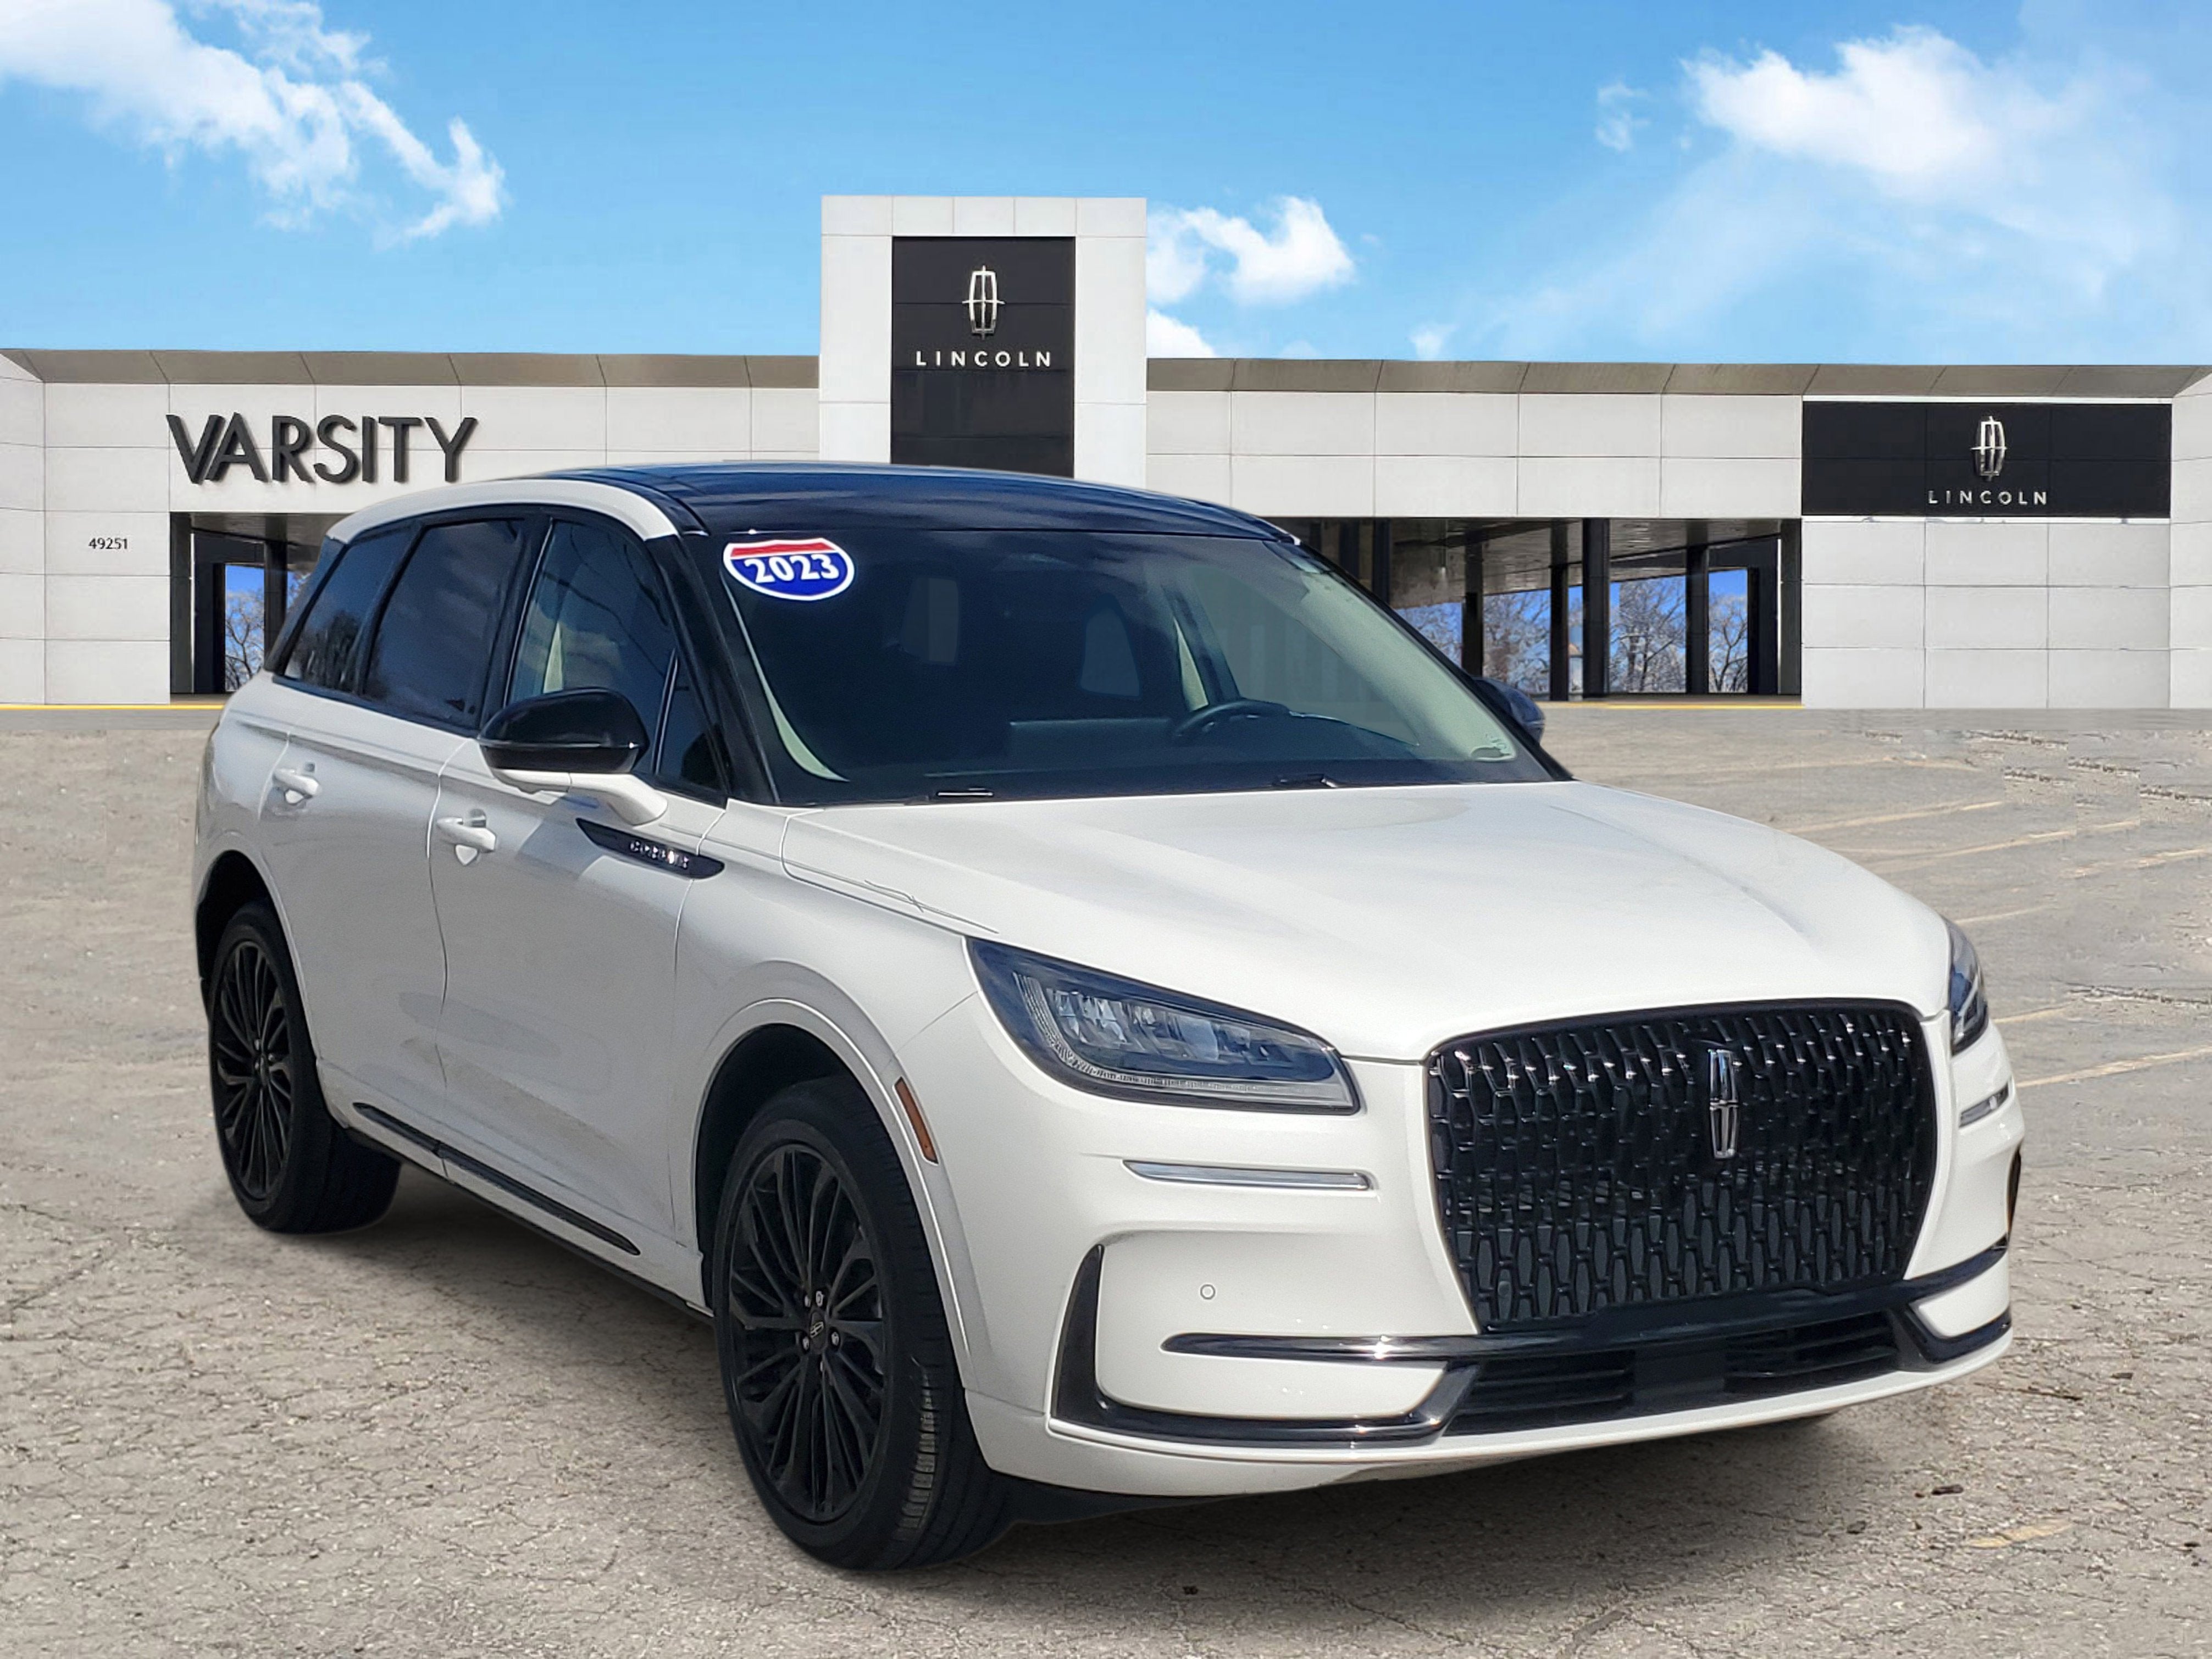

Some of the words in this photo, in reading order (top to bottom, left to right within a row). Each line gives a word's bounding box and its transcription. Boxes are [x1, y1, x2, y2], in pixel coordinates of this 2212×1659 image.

[916, 351, 1051, 367] LINCOLN
[167, 412, 478, 484] VARSITY
[1928, 490, 2048, 505] LINCOLN
[88, 537, 128, 550] 49251
[744, 554, 840, 583] 2023
